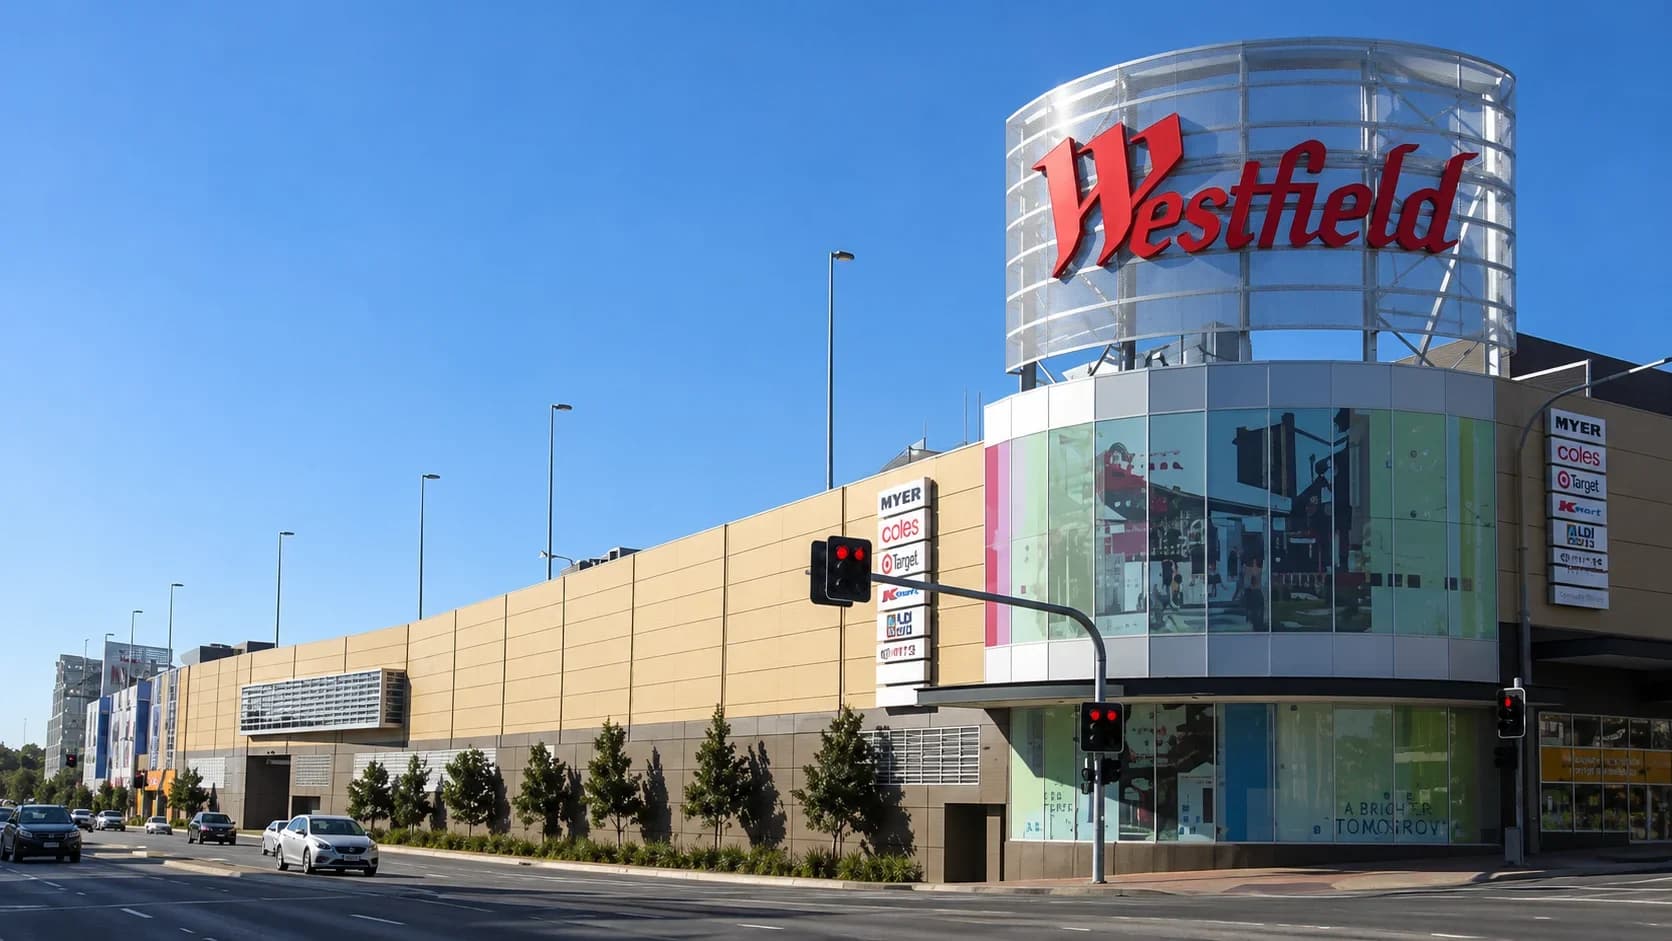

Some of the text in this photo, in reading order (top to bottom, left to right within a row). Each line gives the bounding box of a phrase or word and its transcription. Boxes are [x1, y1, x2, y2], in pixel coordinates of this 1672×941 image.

[1031, 113, 1479, 278] Westfield
[1555, 416, 1601, 437] MYER
[1558, 446, 1600, 466] coles
[1570, 474, 1600, 494] Target
[881, 487, 921, 511] MYER
[882, 518, 919, 543] coles
[893, 550, 919, 571] Target
[1344, 802, 1353, 815] A
